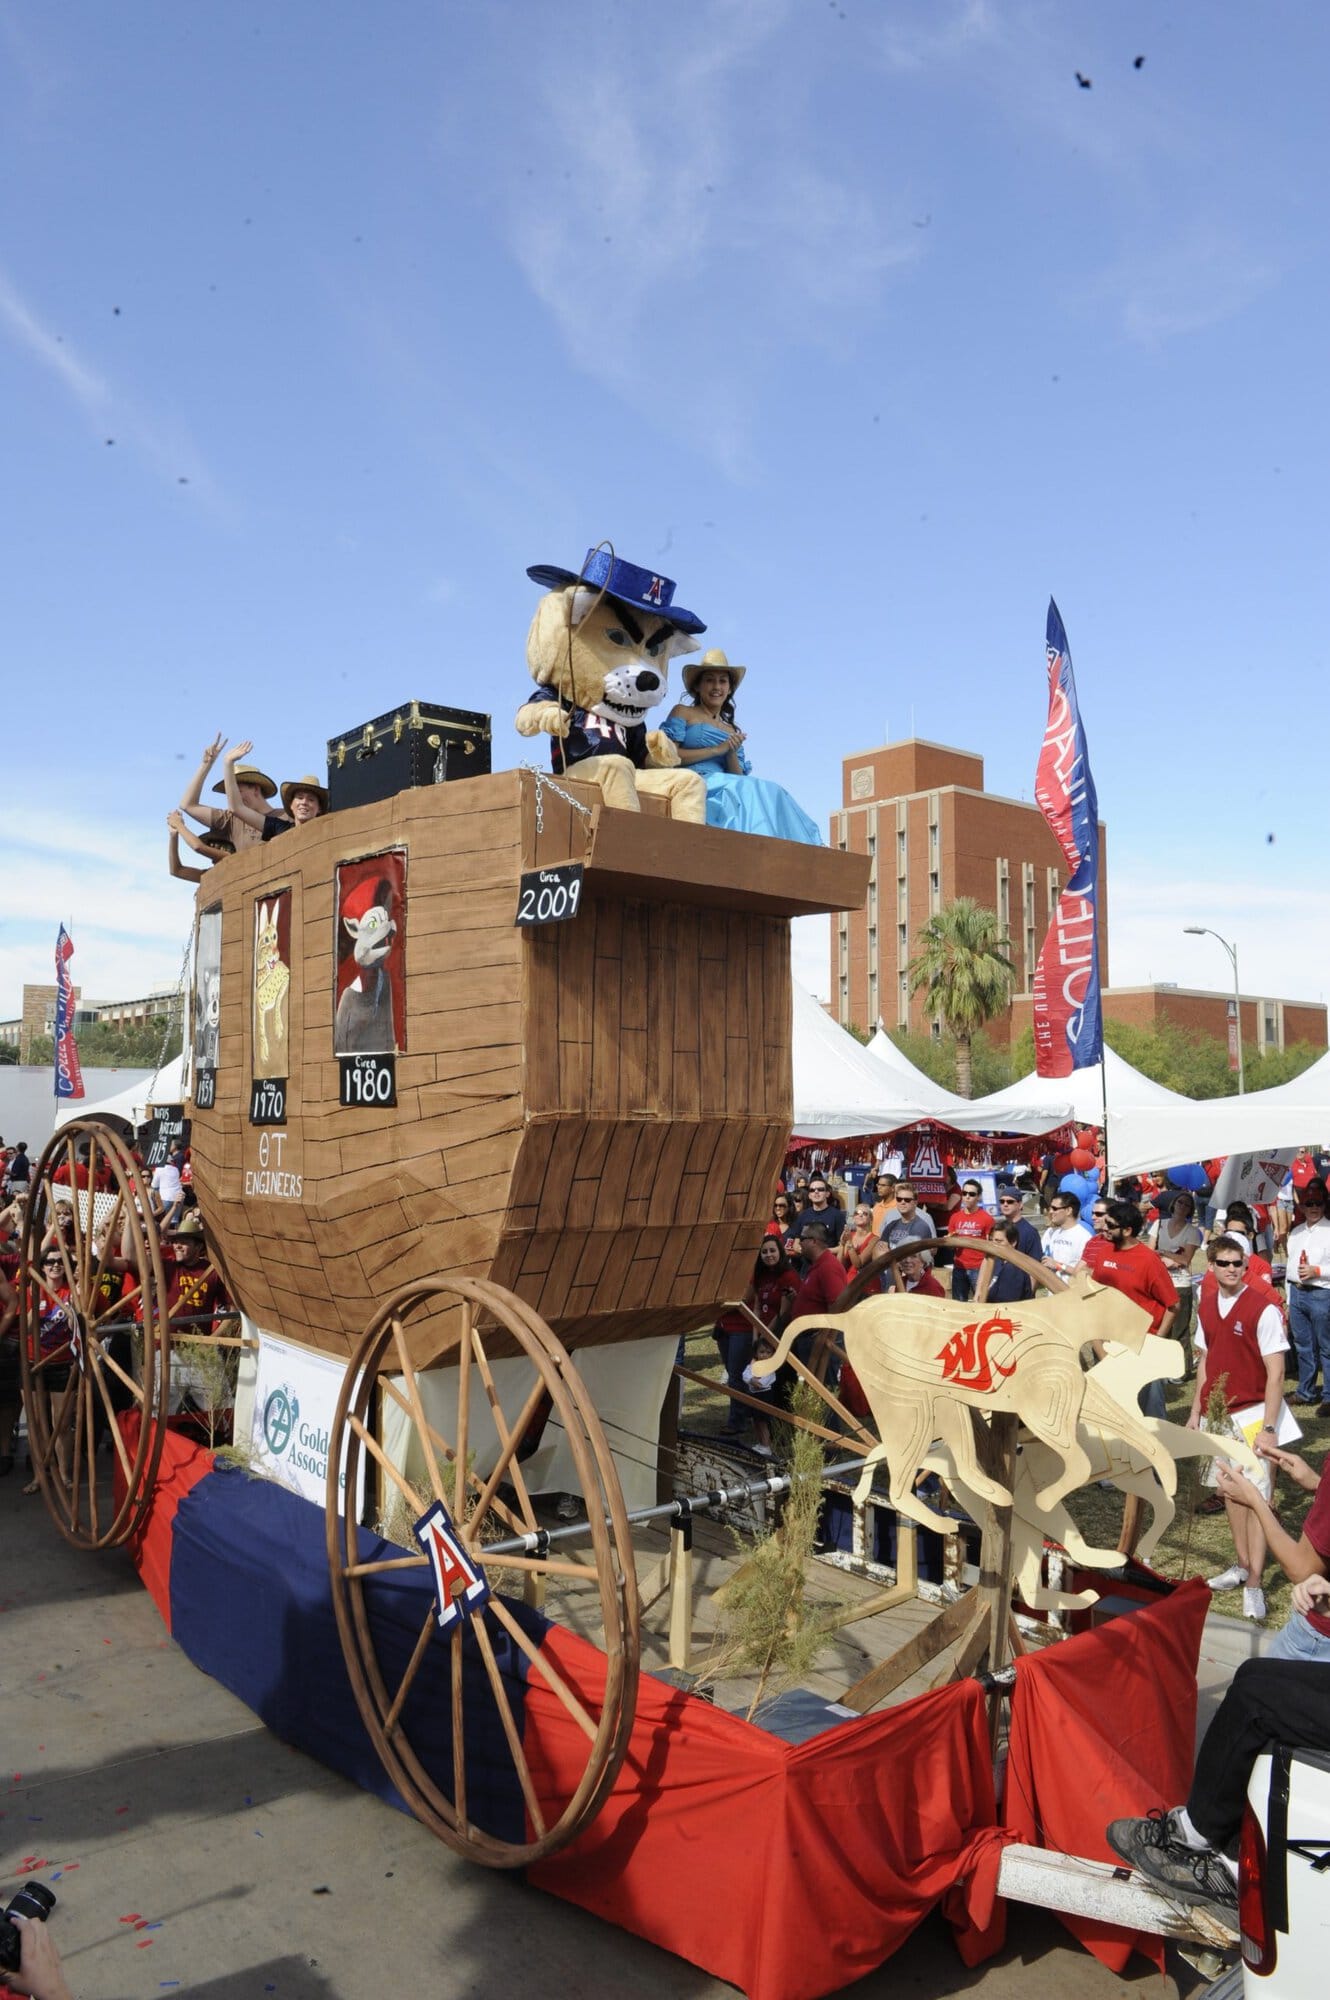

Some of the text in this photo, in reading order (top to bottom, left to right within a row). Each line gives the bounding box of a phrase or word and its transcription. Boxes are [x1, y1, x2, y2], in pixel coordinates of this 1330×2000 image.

[642, 576, 665, 605] A
[539, 870, 561, 883] Circa
[517, 879, 580, 920] 2009
[355, 1055, 377, 1069] Circa
[346, 1068, 391, 1102] 1980
[253, 1091, 283, 1118] 1970
[909, 1136, 944, 1178] A
[245, 1171, 303, 1198] ENGINEERS
[299, 1422, 331, 1455] Gold
[417, 1508, 486, 1627] A
